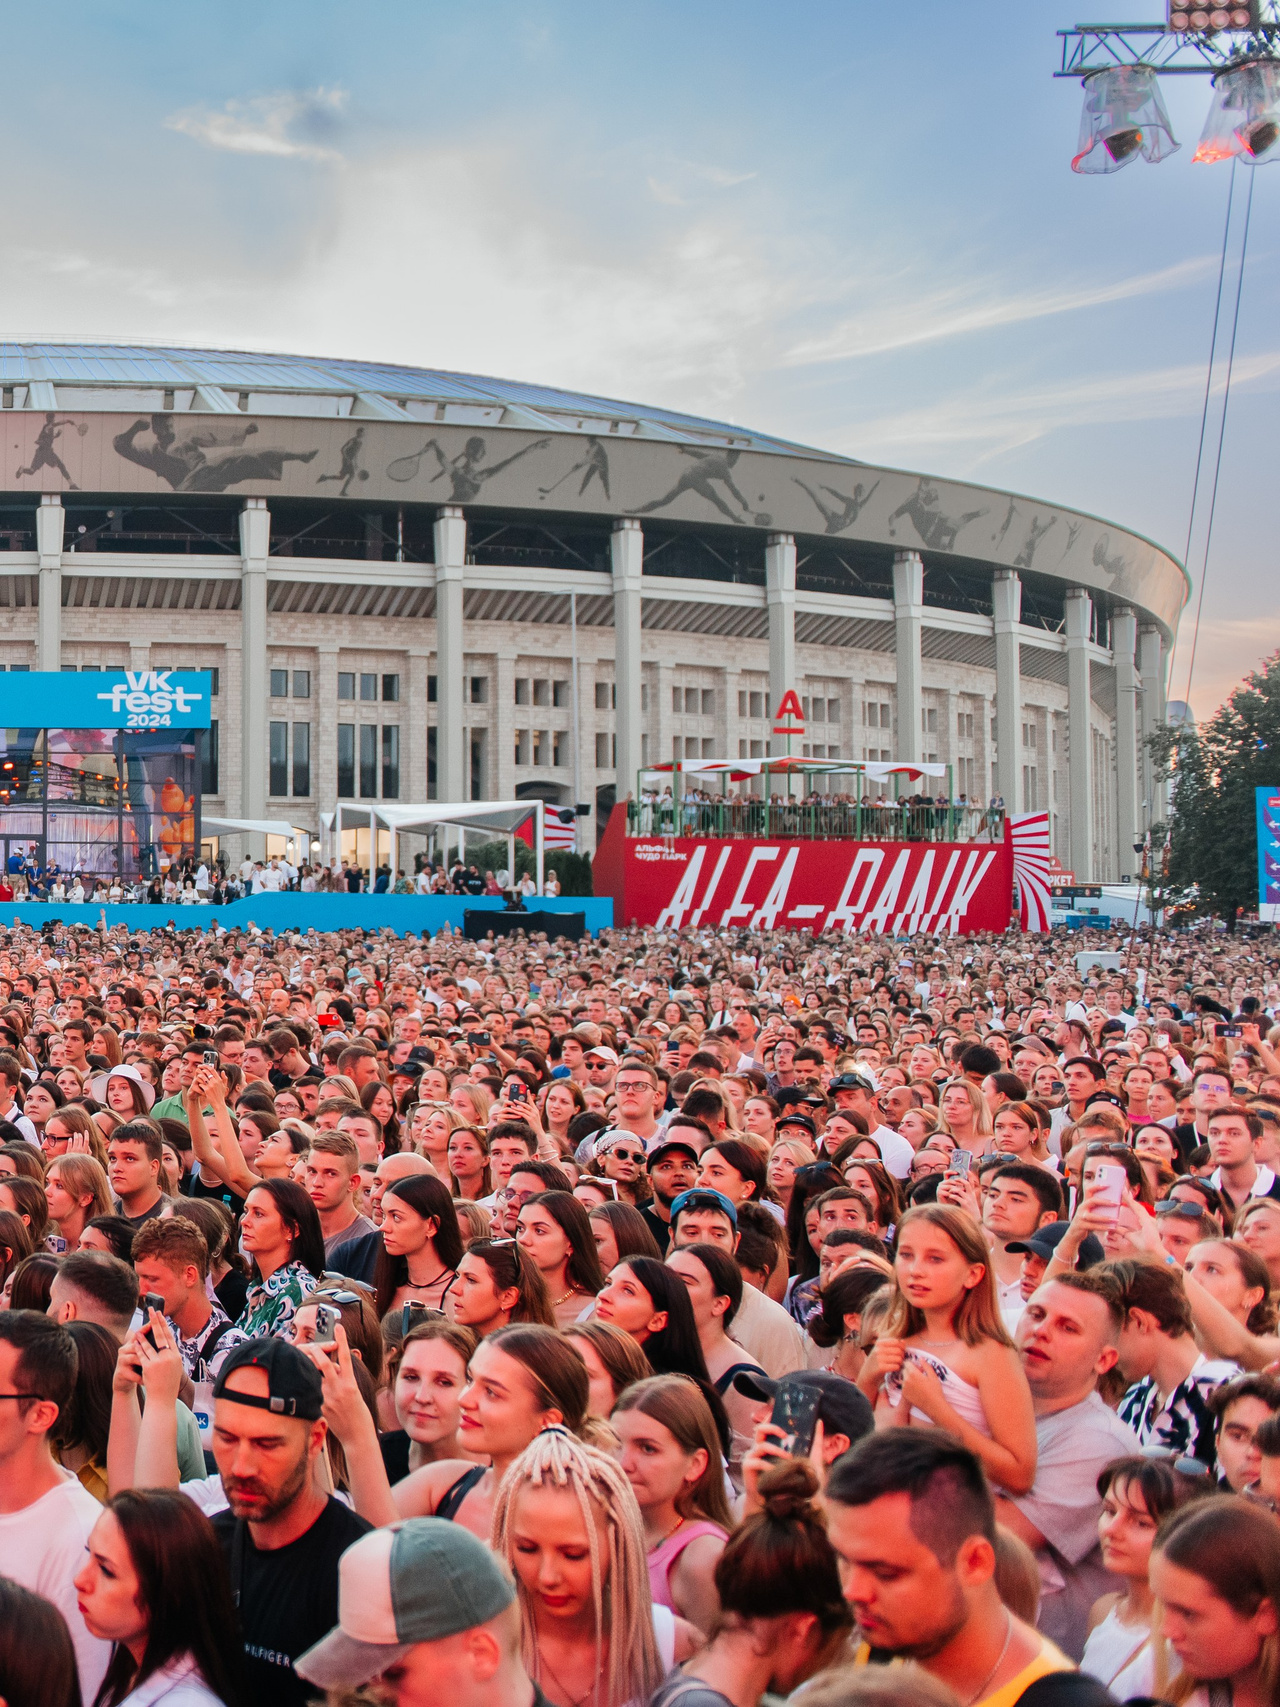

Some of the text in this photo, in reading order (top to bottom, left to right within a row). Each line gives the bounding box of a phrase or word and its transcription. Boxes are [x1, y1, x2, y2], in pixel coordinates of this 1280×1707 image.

[125, 671, 173, 691] VK
[96, 684, 202, 713] fest
[126, 714, 172, 727] 2024
[634, 852, 687, 861] ЧУДО ПАРК
[654, 845, 997, 938] ALFA-BANK
[244, 1642, 290, 1668] HILFIGER
